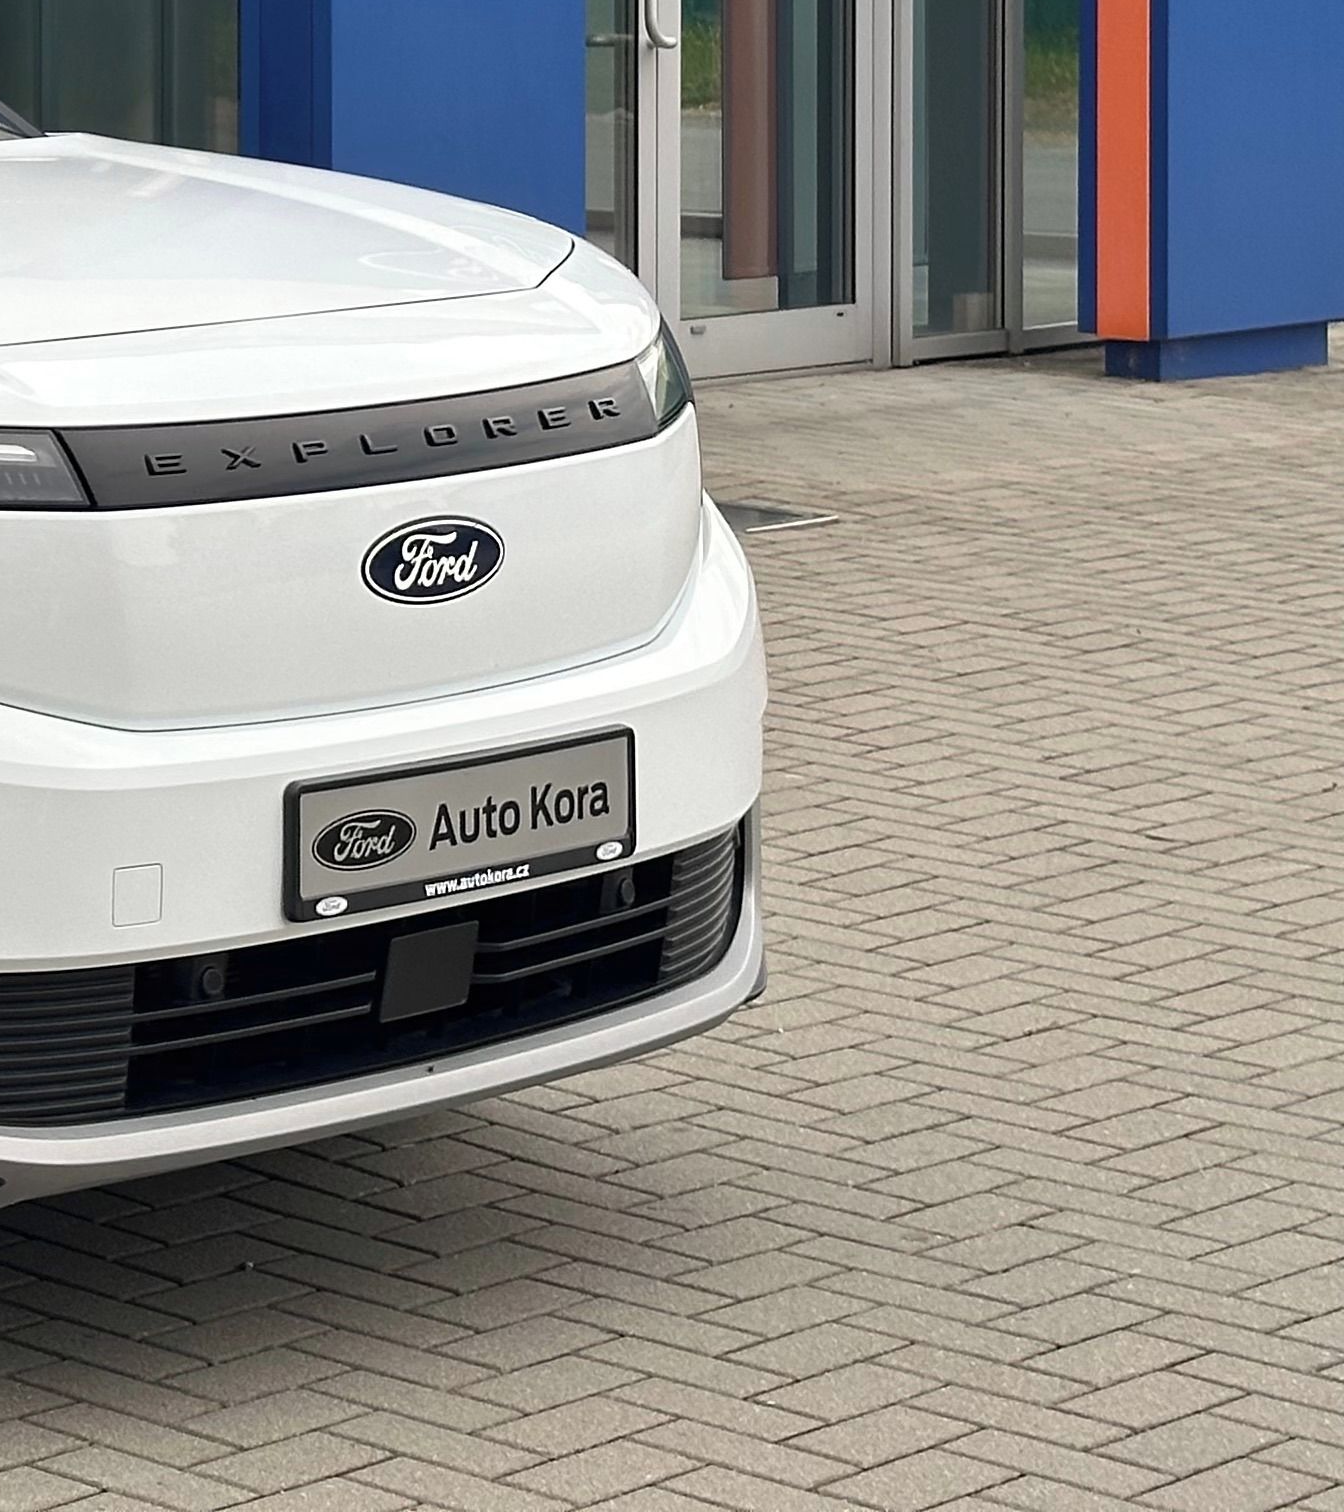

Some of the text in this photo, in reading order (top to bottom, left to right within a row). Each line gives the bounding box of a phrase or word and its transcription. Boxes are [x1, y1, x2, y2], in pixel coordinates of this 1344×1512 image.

[143, 395, 622, 477] EXPLORER
[394, 530, 478, 591] Ford
[333, 781, 611, 862] Ford Auto Kora
[424, 863, 531, 897] www.autokora.cz
